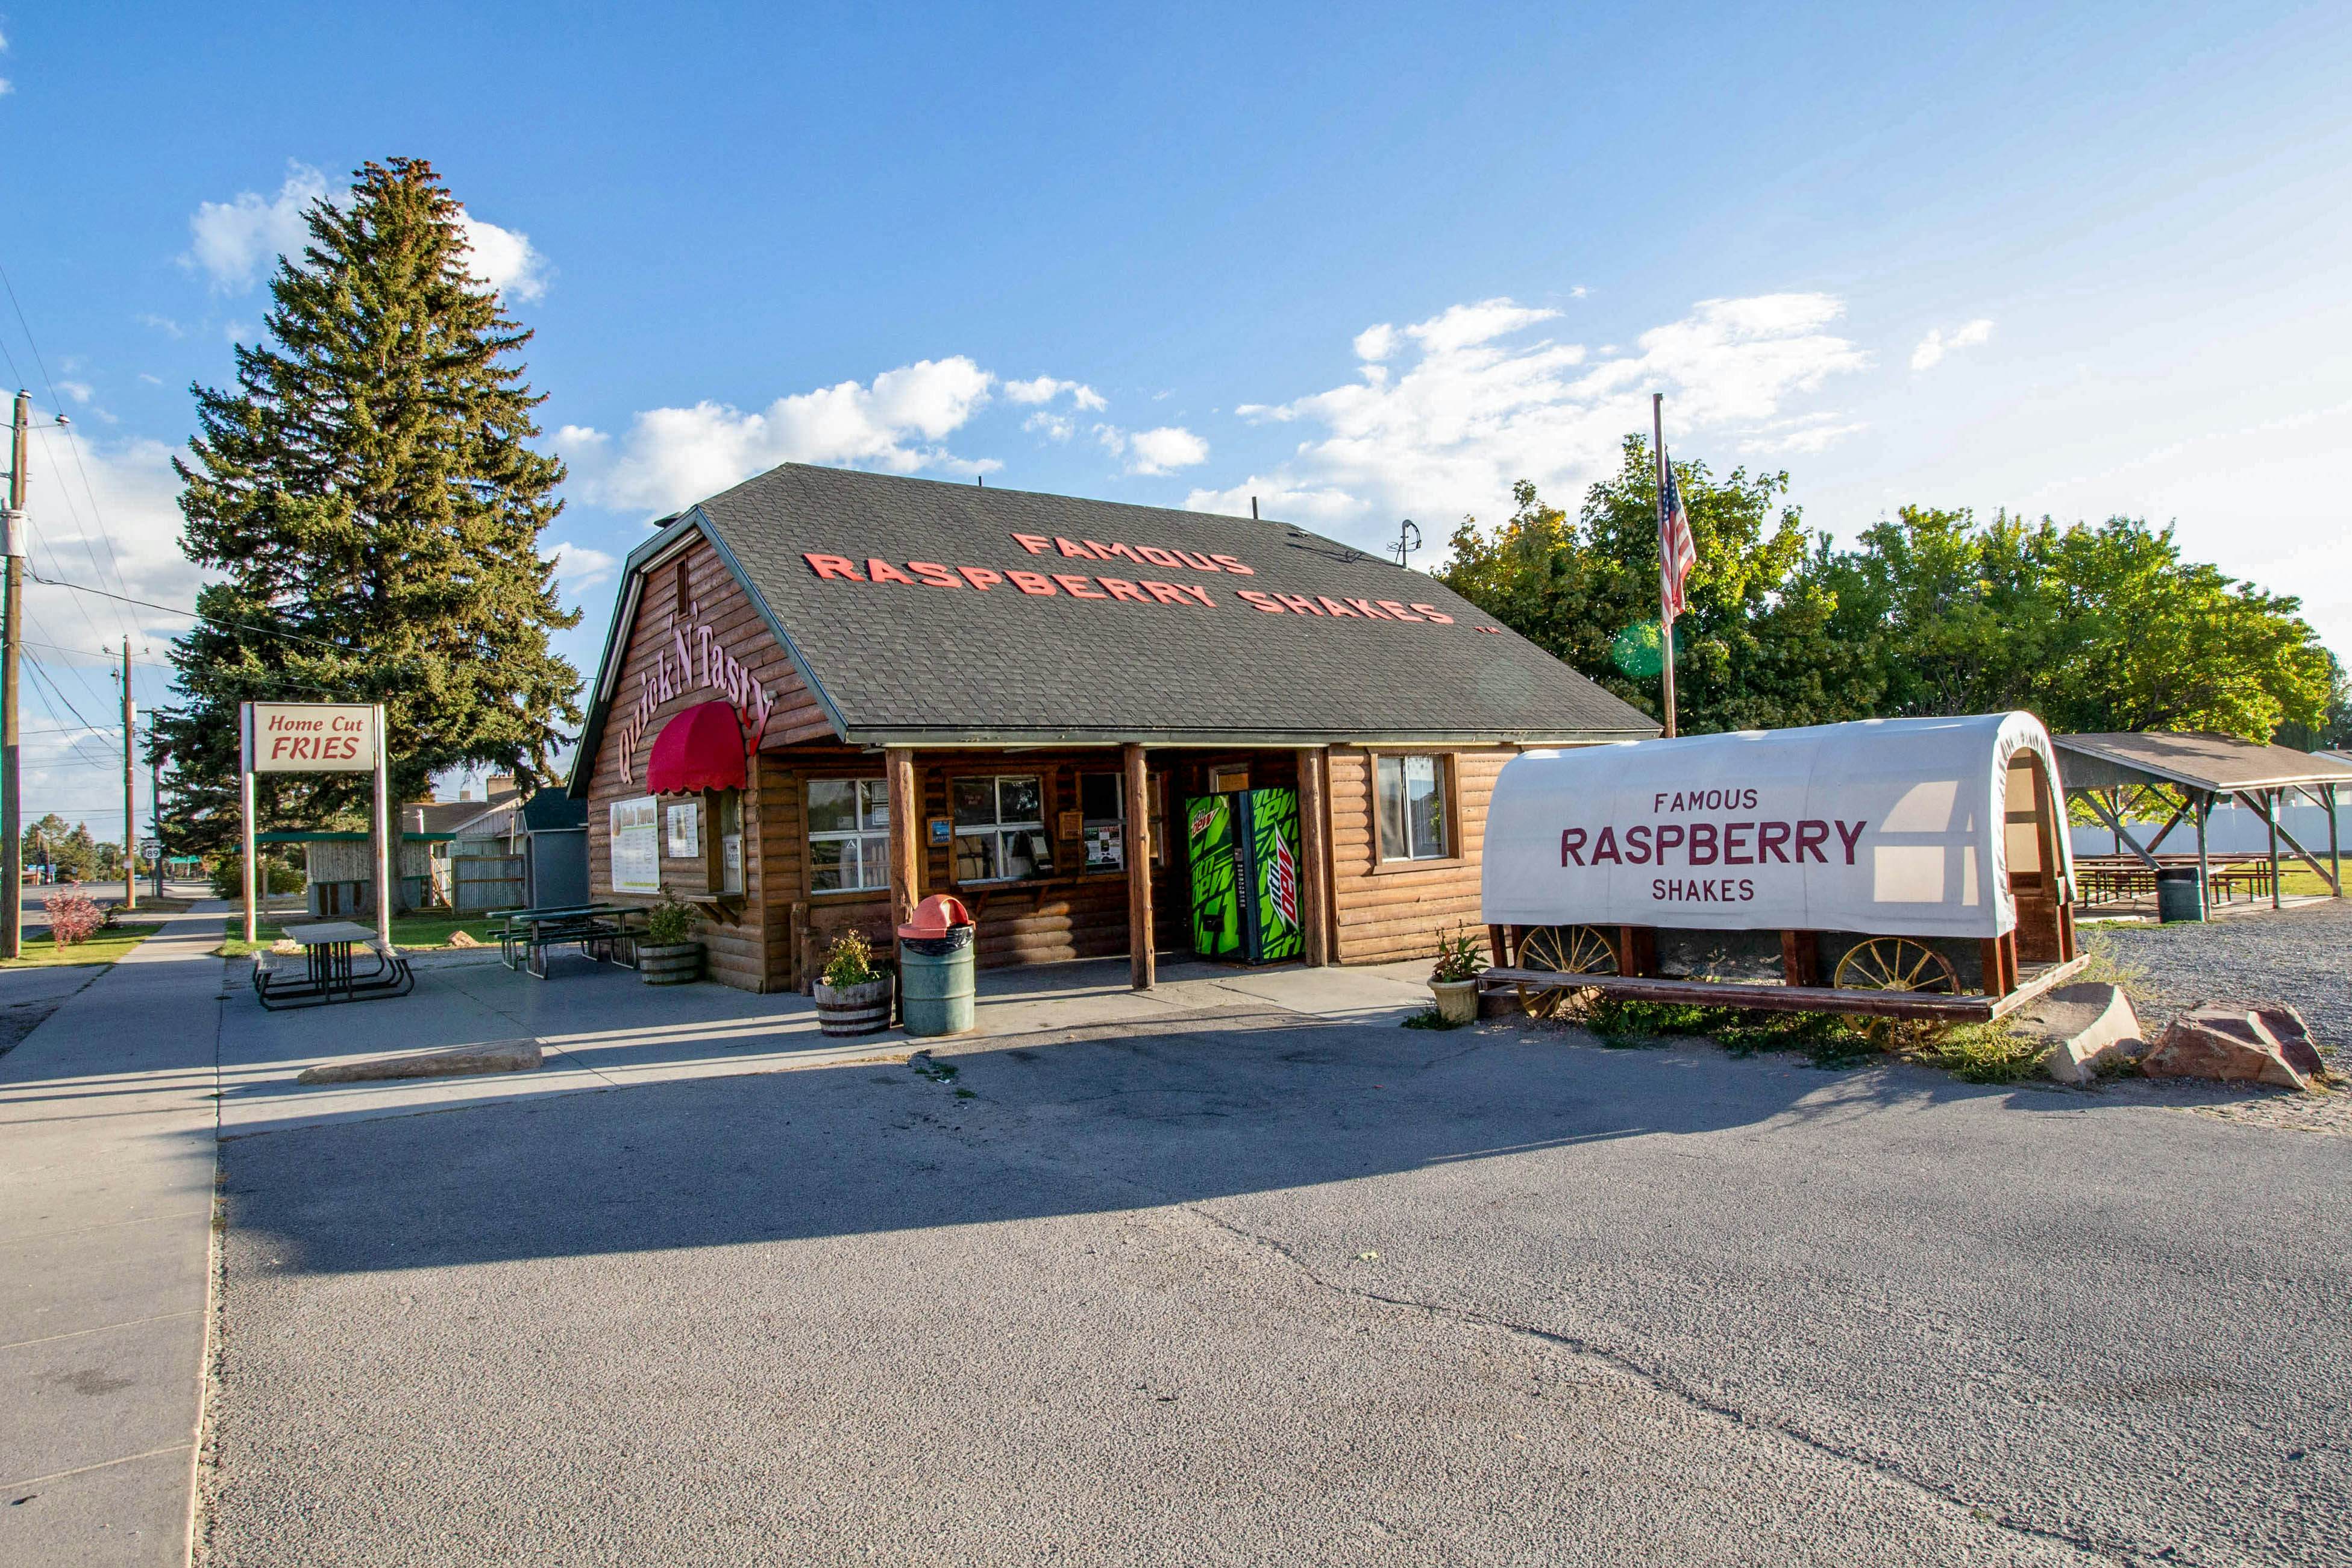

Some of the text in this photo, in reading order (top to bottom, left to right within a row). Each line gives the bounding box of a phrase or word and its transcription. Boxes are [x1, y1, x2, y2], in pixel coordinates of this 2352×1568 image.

[1010, 533, 1254, 575] FAMOUS
[803, 553, 1217, 607] RASPBERRY
[1237, 590, 1454, 624] SHAKES
[619, 649, 674, 785] Quick
[697, 624, 774, 757] Tasty
[269, 715, 364, 732] Home Cut
[272, 736, 360, 760] FRIES
[1654, 789, 1758, 813] FAMOUS
[1561, 820, 1867, 868] RASPBERRY
[1652, 878, 1754, 902] SHAKES
